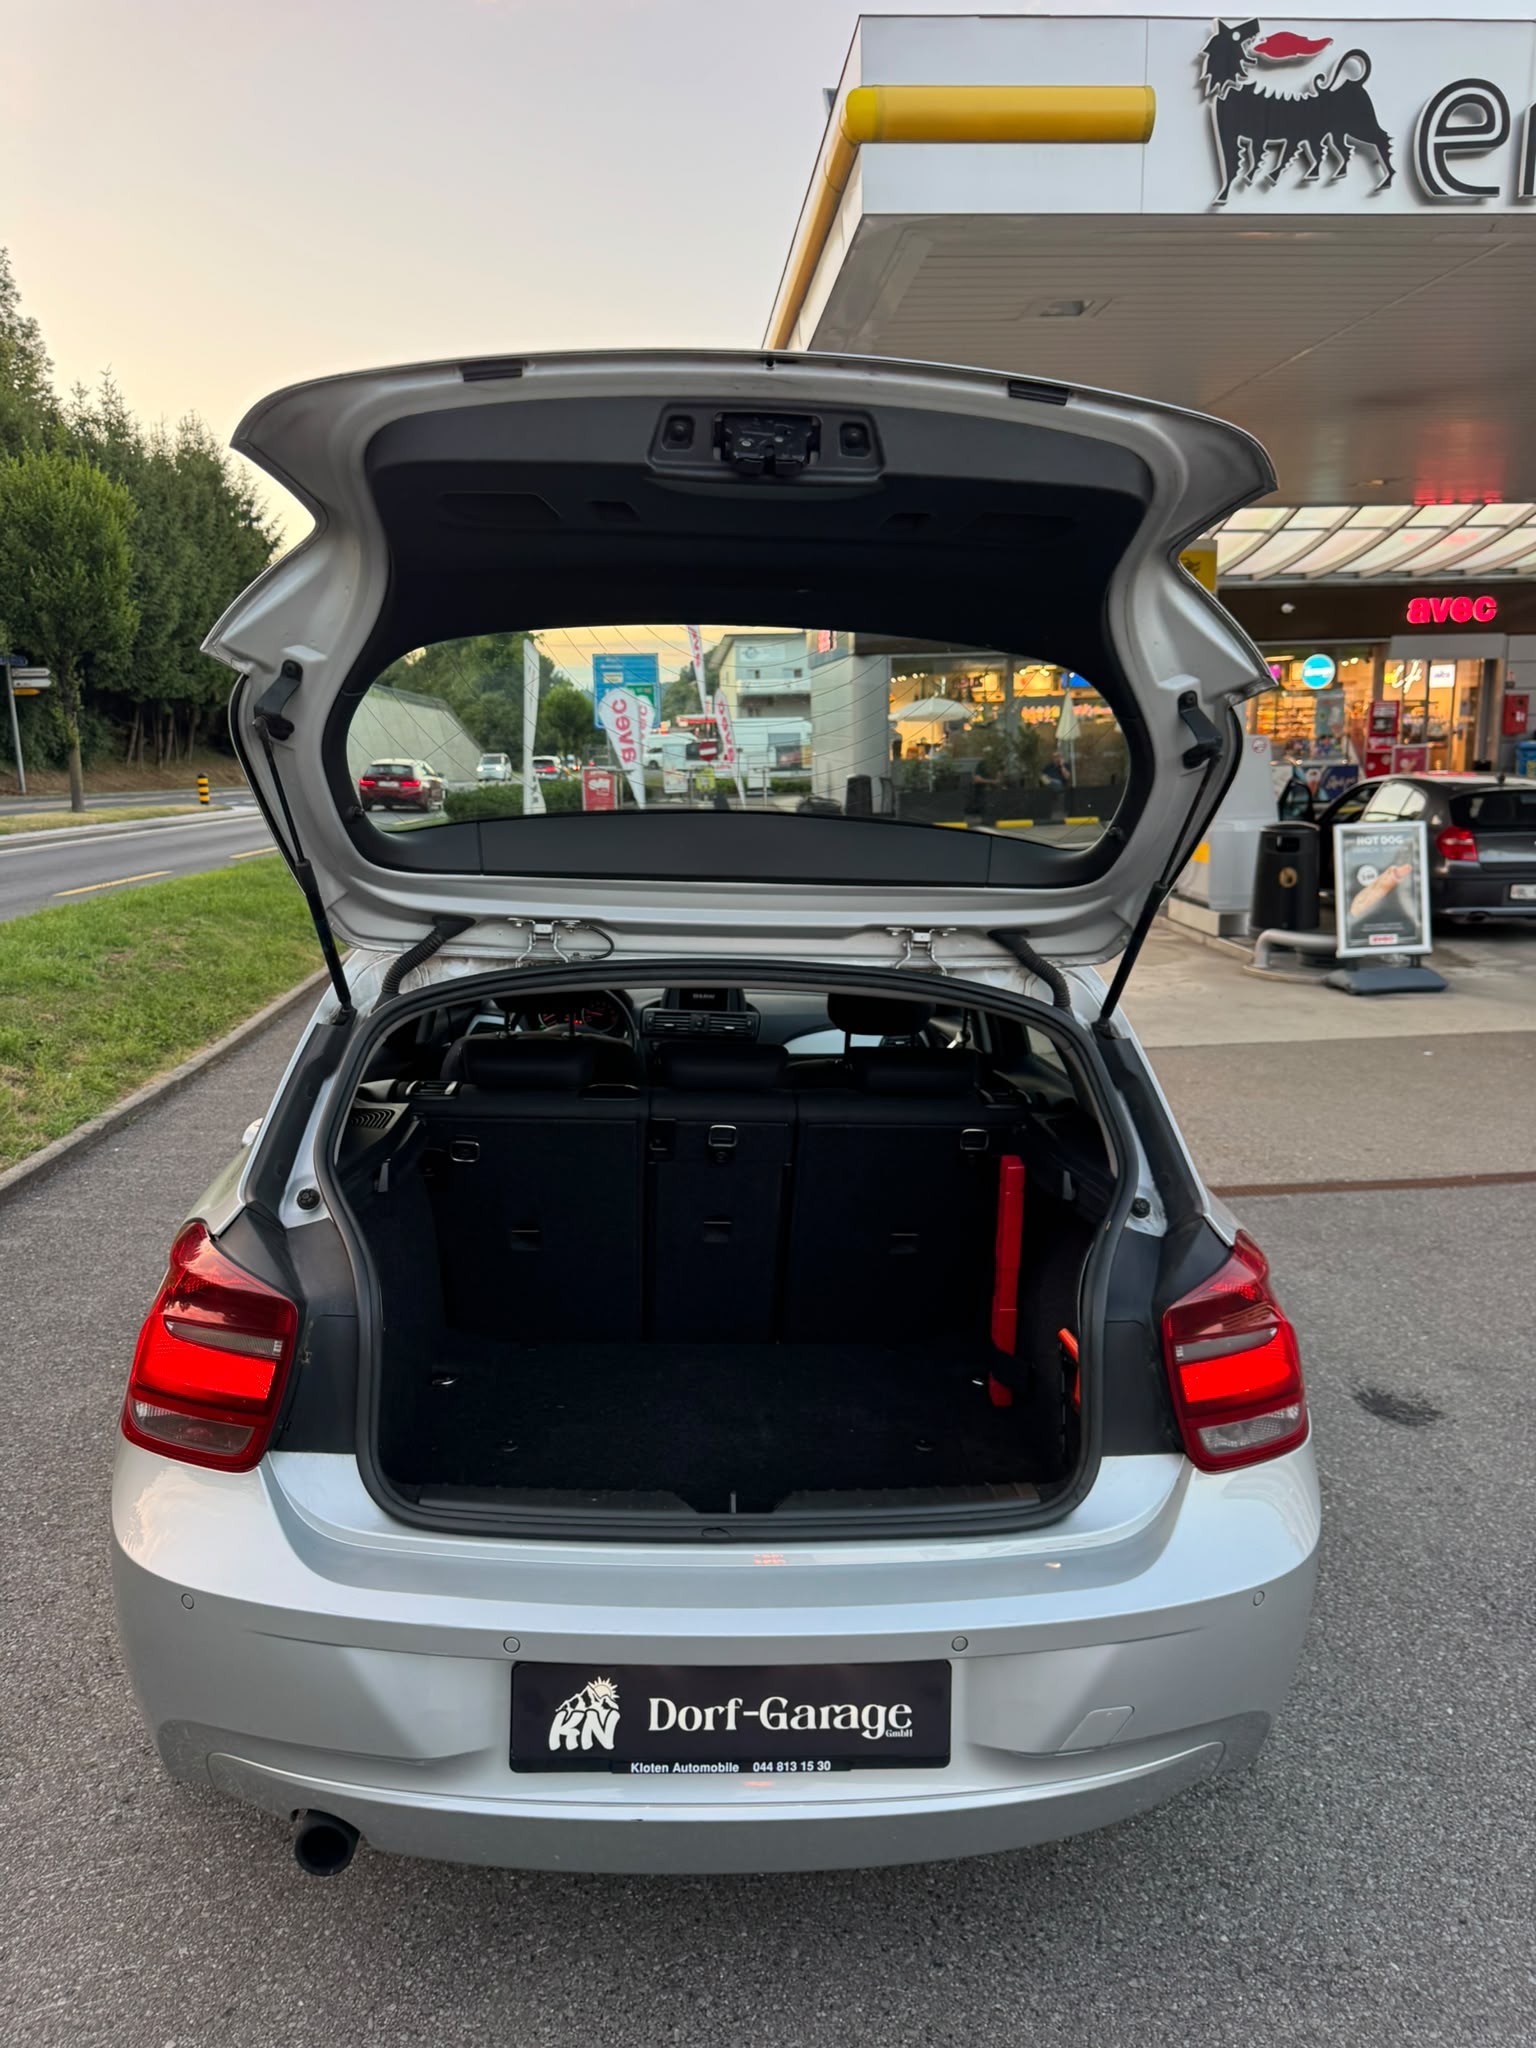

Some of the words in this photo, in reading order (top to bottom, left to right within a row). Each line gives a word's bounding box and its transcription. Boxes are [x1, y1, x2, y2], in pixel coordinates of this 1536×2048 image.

[1414, 77, 1536, 198] e
[1406, 596, 1497, 624] avec
[548, 1709, 620, 1751] KN
[648, 1697, 913, 1740] Dorf-Garage
[630, 1762, 669, 1774] Kloten
[672, 1762, 740, 1774] Automobile
[752, 1761, 773, 1773] 044
[776, 1761, 798, 1772] 813
[801, 1761, 815, 1772] 15
[816, 1761, 832, 1772] 30
